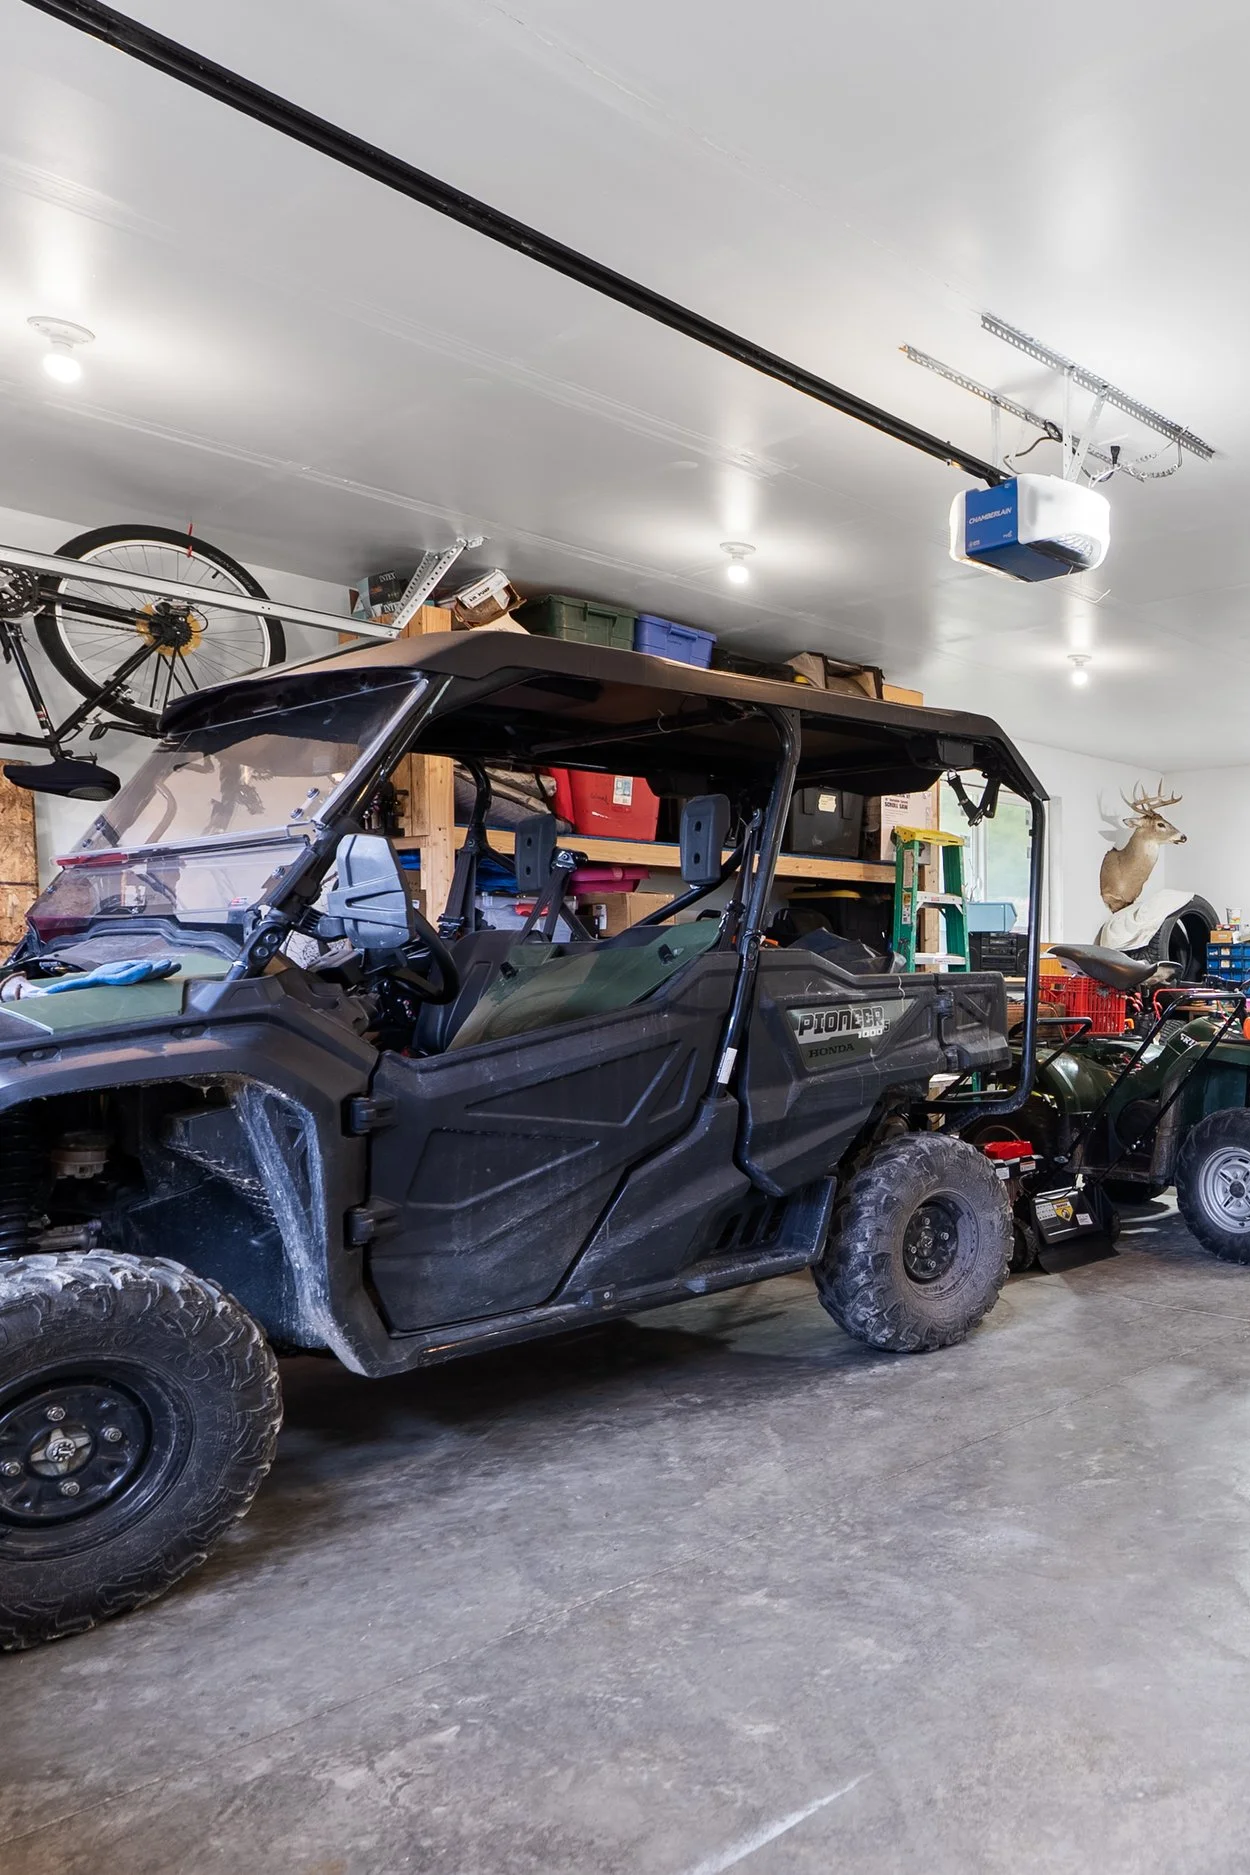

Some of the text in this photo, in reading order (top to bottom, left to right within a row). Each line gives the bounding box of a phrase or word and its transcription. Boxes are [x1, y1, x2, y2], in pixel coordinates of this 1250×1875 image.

[968, 507, 1012, 525] CHAMBERLAIN
[379, 572, 396, 583] INTEX
[798, 1006, 885, 1036] PIONEER
[858, 1028, 883, 1039] 1000
[808, 1043, 855, 1058] HONDA
